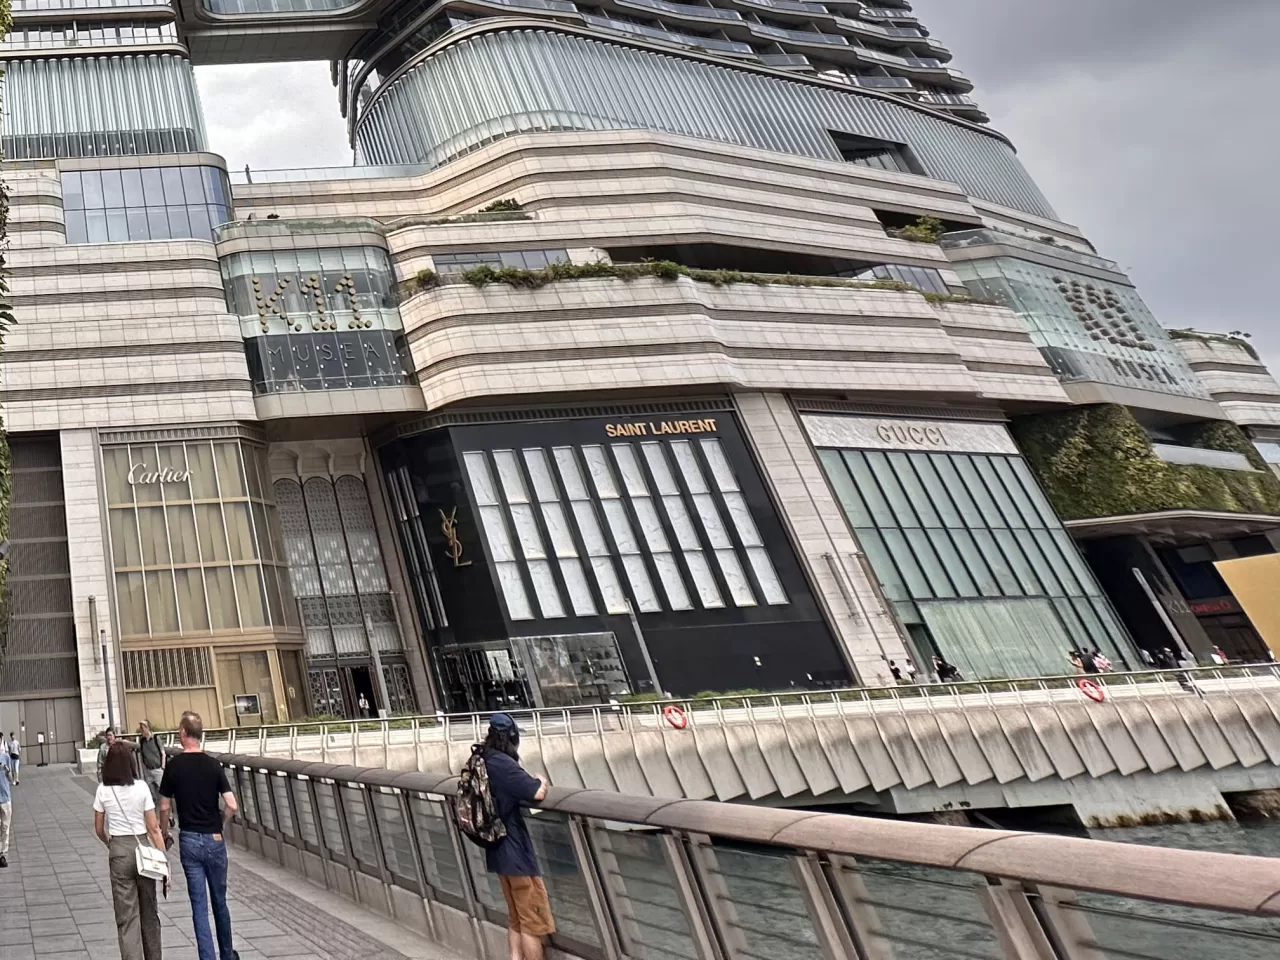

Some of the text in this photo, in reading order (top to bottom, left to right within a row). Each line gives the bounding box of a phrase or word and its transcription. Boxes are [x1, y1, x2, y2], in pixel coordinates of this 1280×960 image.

[252, 273, 373, 333] K11
[267, 343, 380, 365] MUSEA
[1107, 357, 1179, 385] MUSEA
[605, 419, 717, 437] SAINT LAURENT
[876, 425, 949, 446] GUCCI
[127, 462, 194, 485] Cartier
